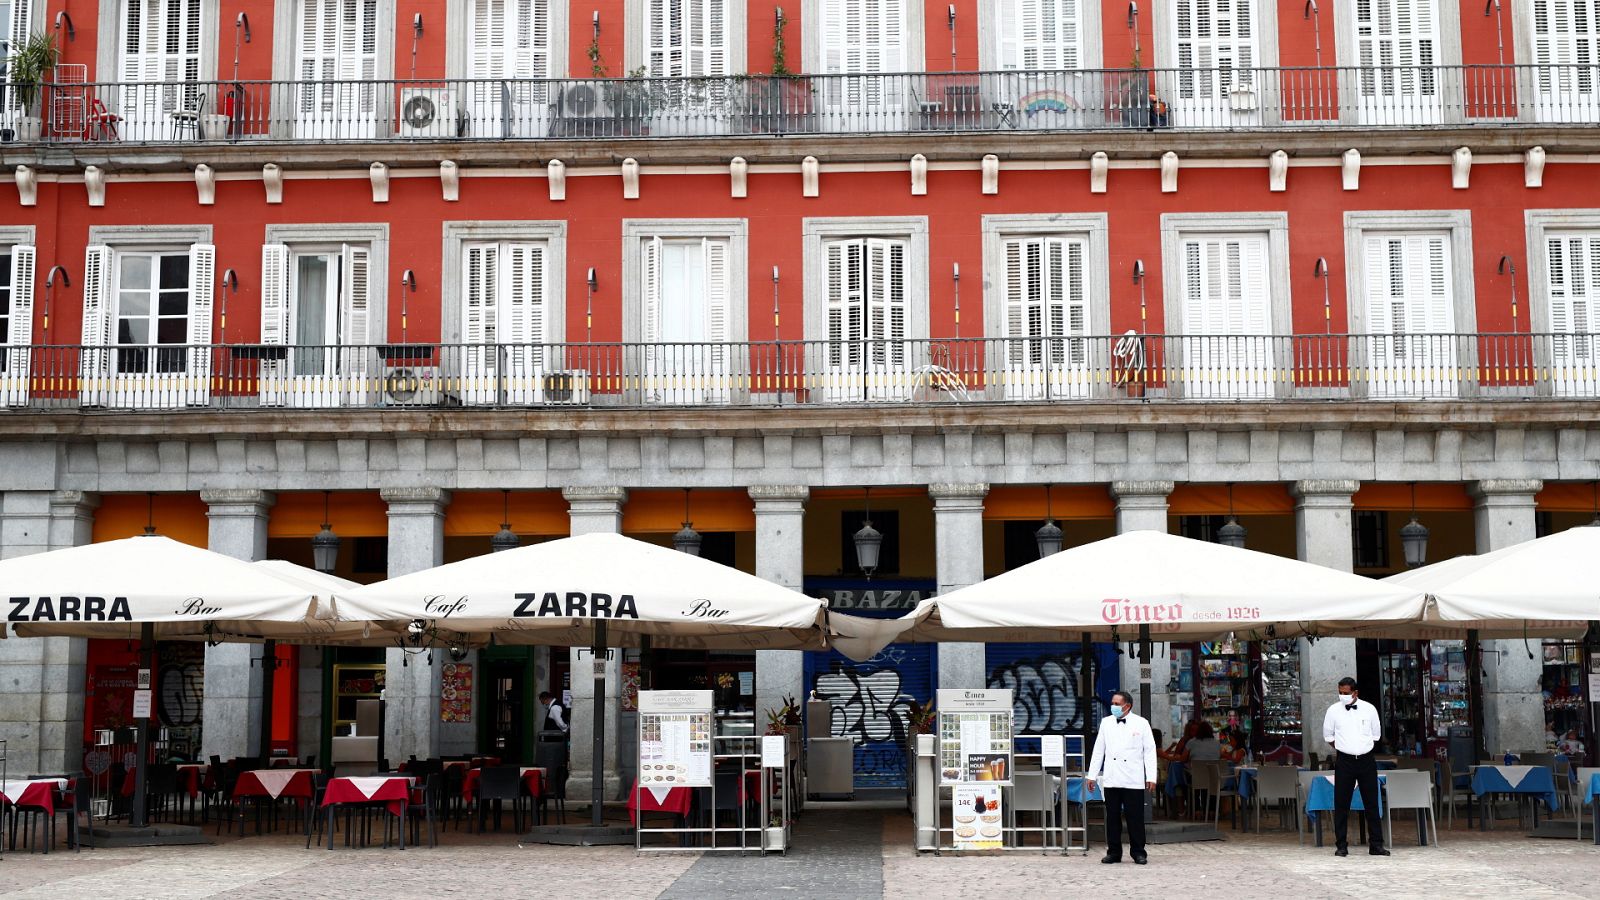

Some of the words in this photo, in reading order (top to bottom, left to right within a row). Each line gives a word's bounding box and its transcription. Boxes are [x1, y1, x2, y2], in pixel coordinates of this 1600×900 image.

[8, 596, 133, 621] ZARRA
[174, 597, 223, 616] Bar
[423, 594, 468, 618] Café
[513, 592, 639, 619] ZARRA
[681, 599, 729, 618] Bar
[832, 590, 937, 608] BAZA
[1102, 598, 1183, 624] Tineo
[1192, 611, 1222, 620] desde
[1227, 607, 1261, 619] 1926
